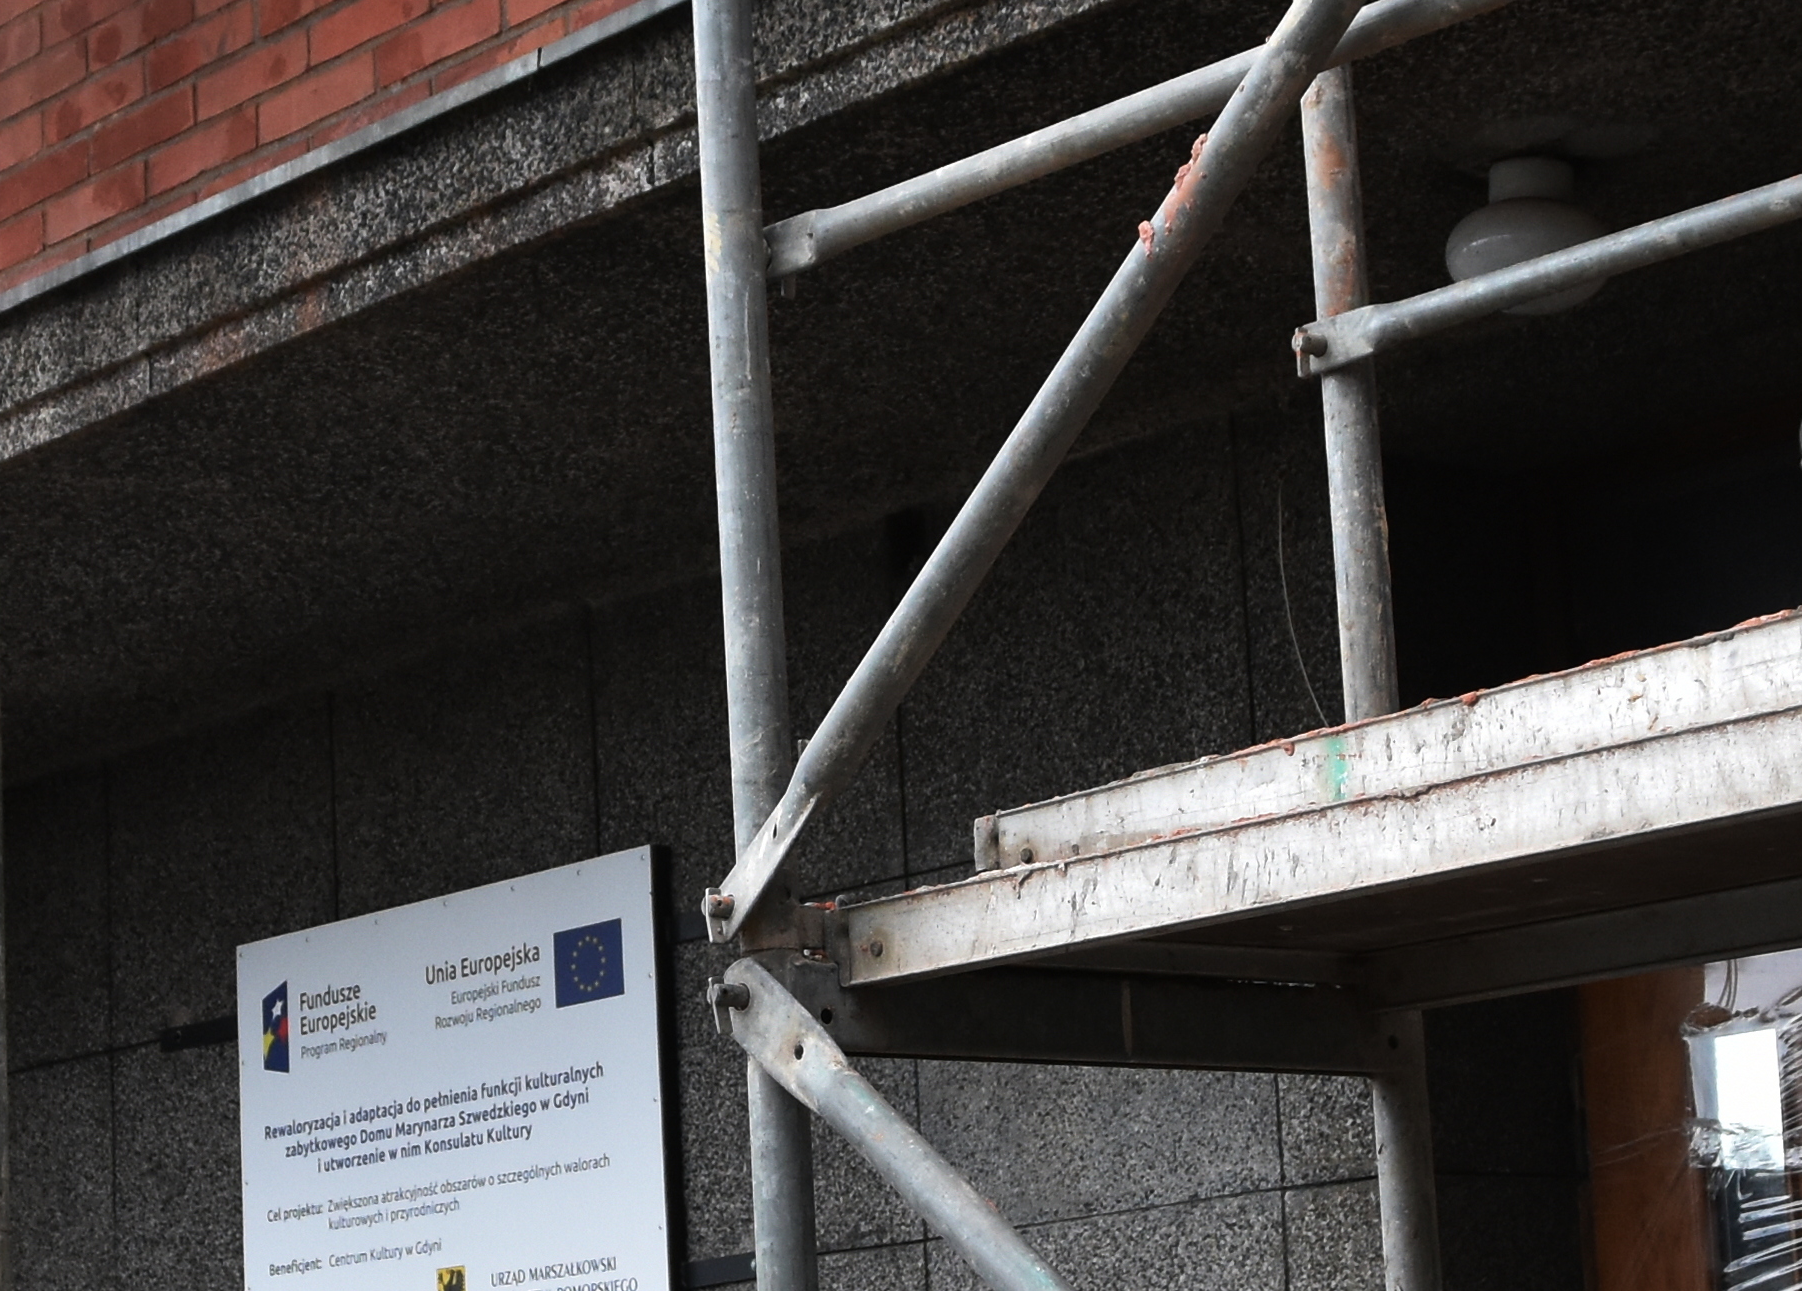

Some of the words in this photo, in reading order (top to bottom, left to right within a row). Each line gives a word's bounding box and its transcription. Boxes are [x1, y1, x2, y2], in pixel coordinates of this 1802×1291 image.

[425, 961, 457, 985] Unia
[461, 942, 540, 977] Europejska
[299, 984, 361, 1011] Fundusze
[451, 981, 499, 1005] Europejski
[501, 975, 541, 994] Fundusz
[300, 1001, 377, 1035] Europejskie
[435, 1009, 474, 1029] Rozwoju
[476, 997, 541, 1022] Regionalnego
[301, 1041, 337, 1059] Program
[339, 1030, 387, 1052] Regionalny
[264, 1112, 341, 1140] Rewaloryzacja
[343, 1109, 347, 1125] i
[349, 1100, 403, 1124] adaptacja
[406, 1096, 421, 1113] do
[423, 1086, 478, 1113] pełnienia
[481, 1076, 522, 1099] funkcji
[525, 1061, 604, 1091] kulturalnych
[285, 1134, 357, 1158] zabytkowego
[360, 1127, 392, 1144] Domu
[395, 1115, 456, 1137] Marynarza
[458, 1100, 537, 1126] Szwedzkiego
[540, 1097, 550, 1111] w
[553, 1087, 589, 1110] Gdyni
[318, 1159, 321, 1173] i
[323, 1148, 385, 1173] utworzenie
[388, 1150, 397, 1160] w
[400, 1141, 421, 1158] nim
[424, 1132, 484, 1155] Konsulatu
[487, 1124, 532, 1143] Kultury
[267, 1207, 282, 1223] Cel
[283, 1203, 323, 1222] projektu:
[327, 1194, 379, 1212] Zwiększona
[381, 1182, 438, 1204] atrakcyjność
[440, 1175, 486, 1194] obszarów
[488, 1176, 495, 1186] o
[497, 1163, 561, 1185] szczególnych
[563, 1153, 610, 1174] walorach
[328, 1211, 383, 1230] kulturowych
[385, 1210, 389, 1221] i
[390, 1197, 460, 1224] przyrodniczych
[269, 1258, 322, 1277] Beneficjent:
[329, 1251, 368, 1267] Centrum
[369, 1245, 403, 1260] Kultury
[404, 1245, 414, 1255] w
[415, 1238, 442, 1257] Gdyni
[490, 1269, 526, 1288] URZĄD
[528, 1256, 617, 1282] MARSZAŁKOWSKI
